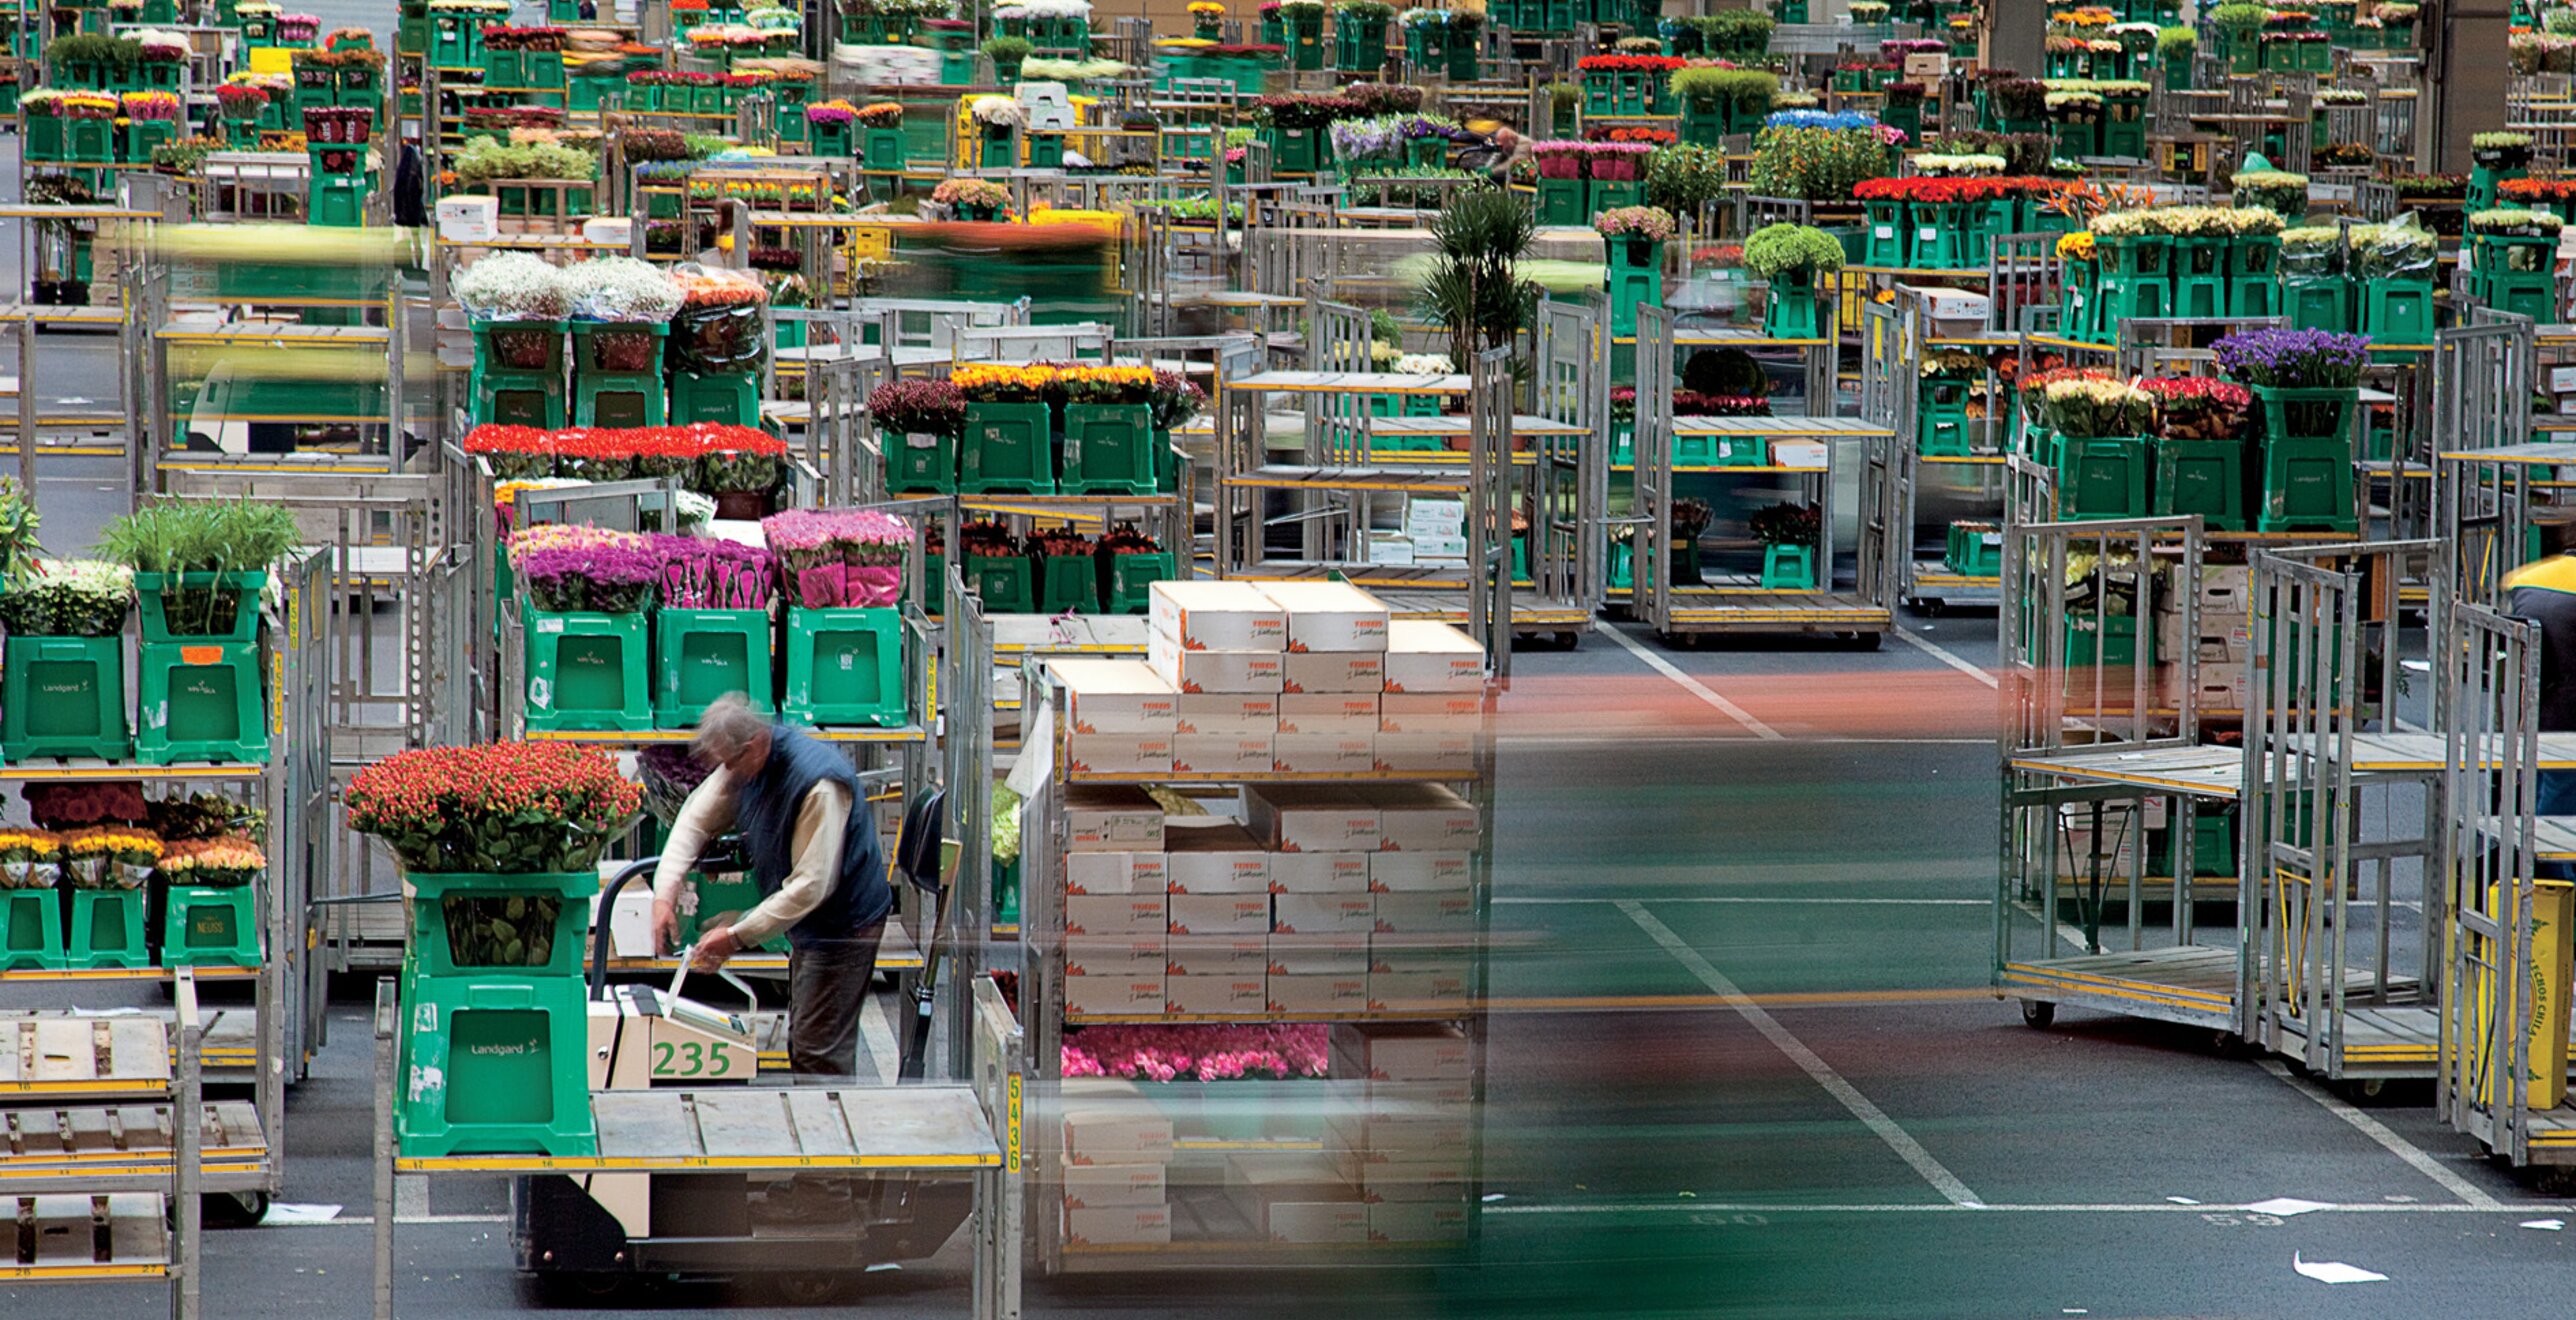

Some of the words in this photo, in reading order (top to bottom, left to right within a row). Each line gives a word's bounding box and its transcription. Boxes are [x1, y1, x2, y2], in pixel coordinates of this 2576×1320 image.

[43, 682, 79, 694] Landgard
[197, 922, 224, 934] NEUSS
[471, 1042, 524, 1057] Landgard
[653, 1041, 730, 1078] 235
[1010, 1079, 1020, 1170] 5436
[800, 1157, 810, 1165] 13
[851, 1157, 862, 1165] 12
[2201, 1213, 2285, 1226] 59
[142, 1265, 157, 1273] 27
